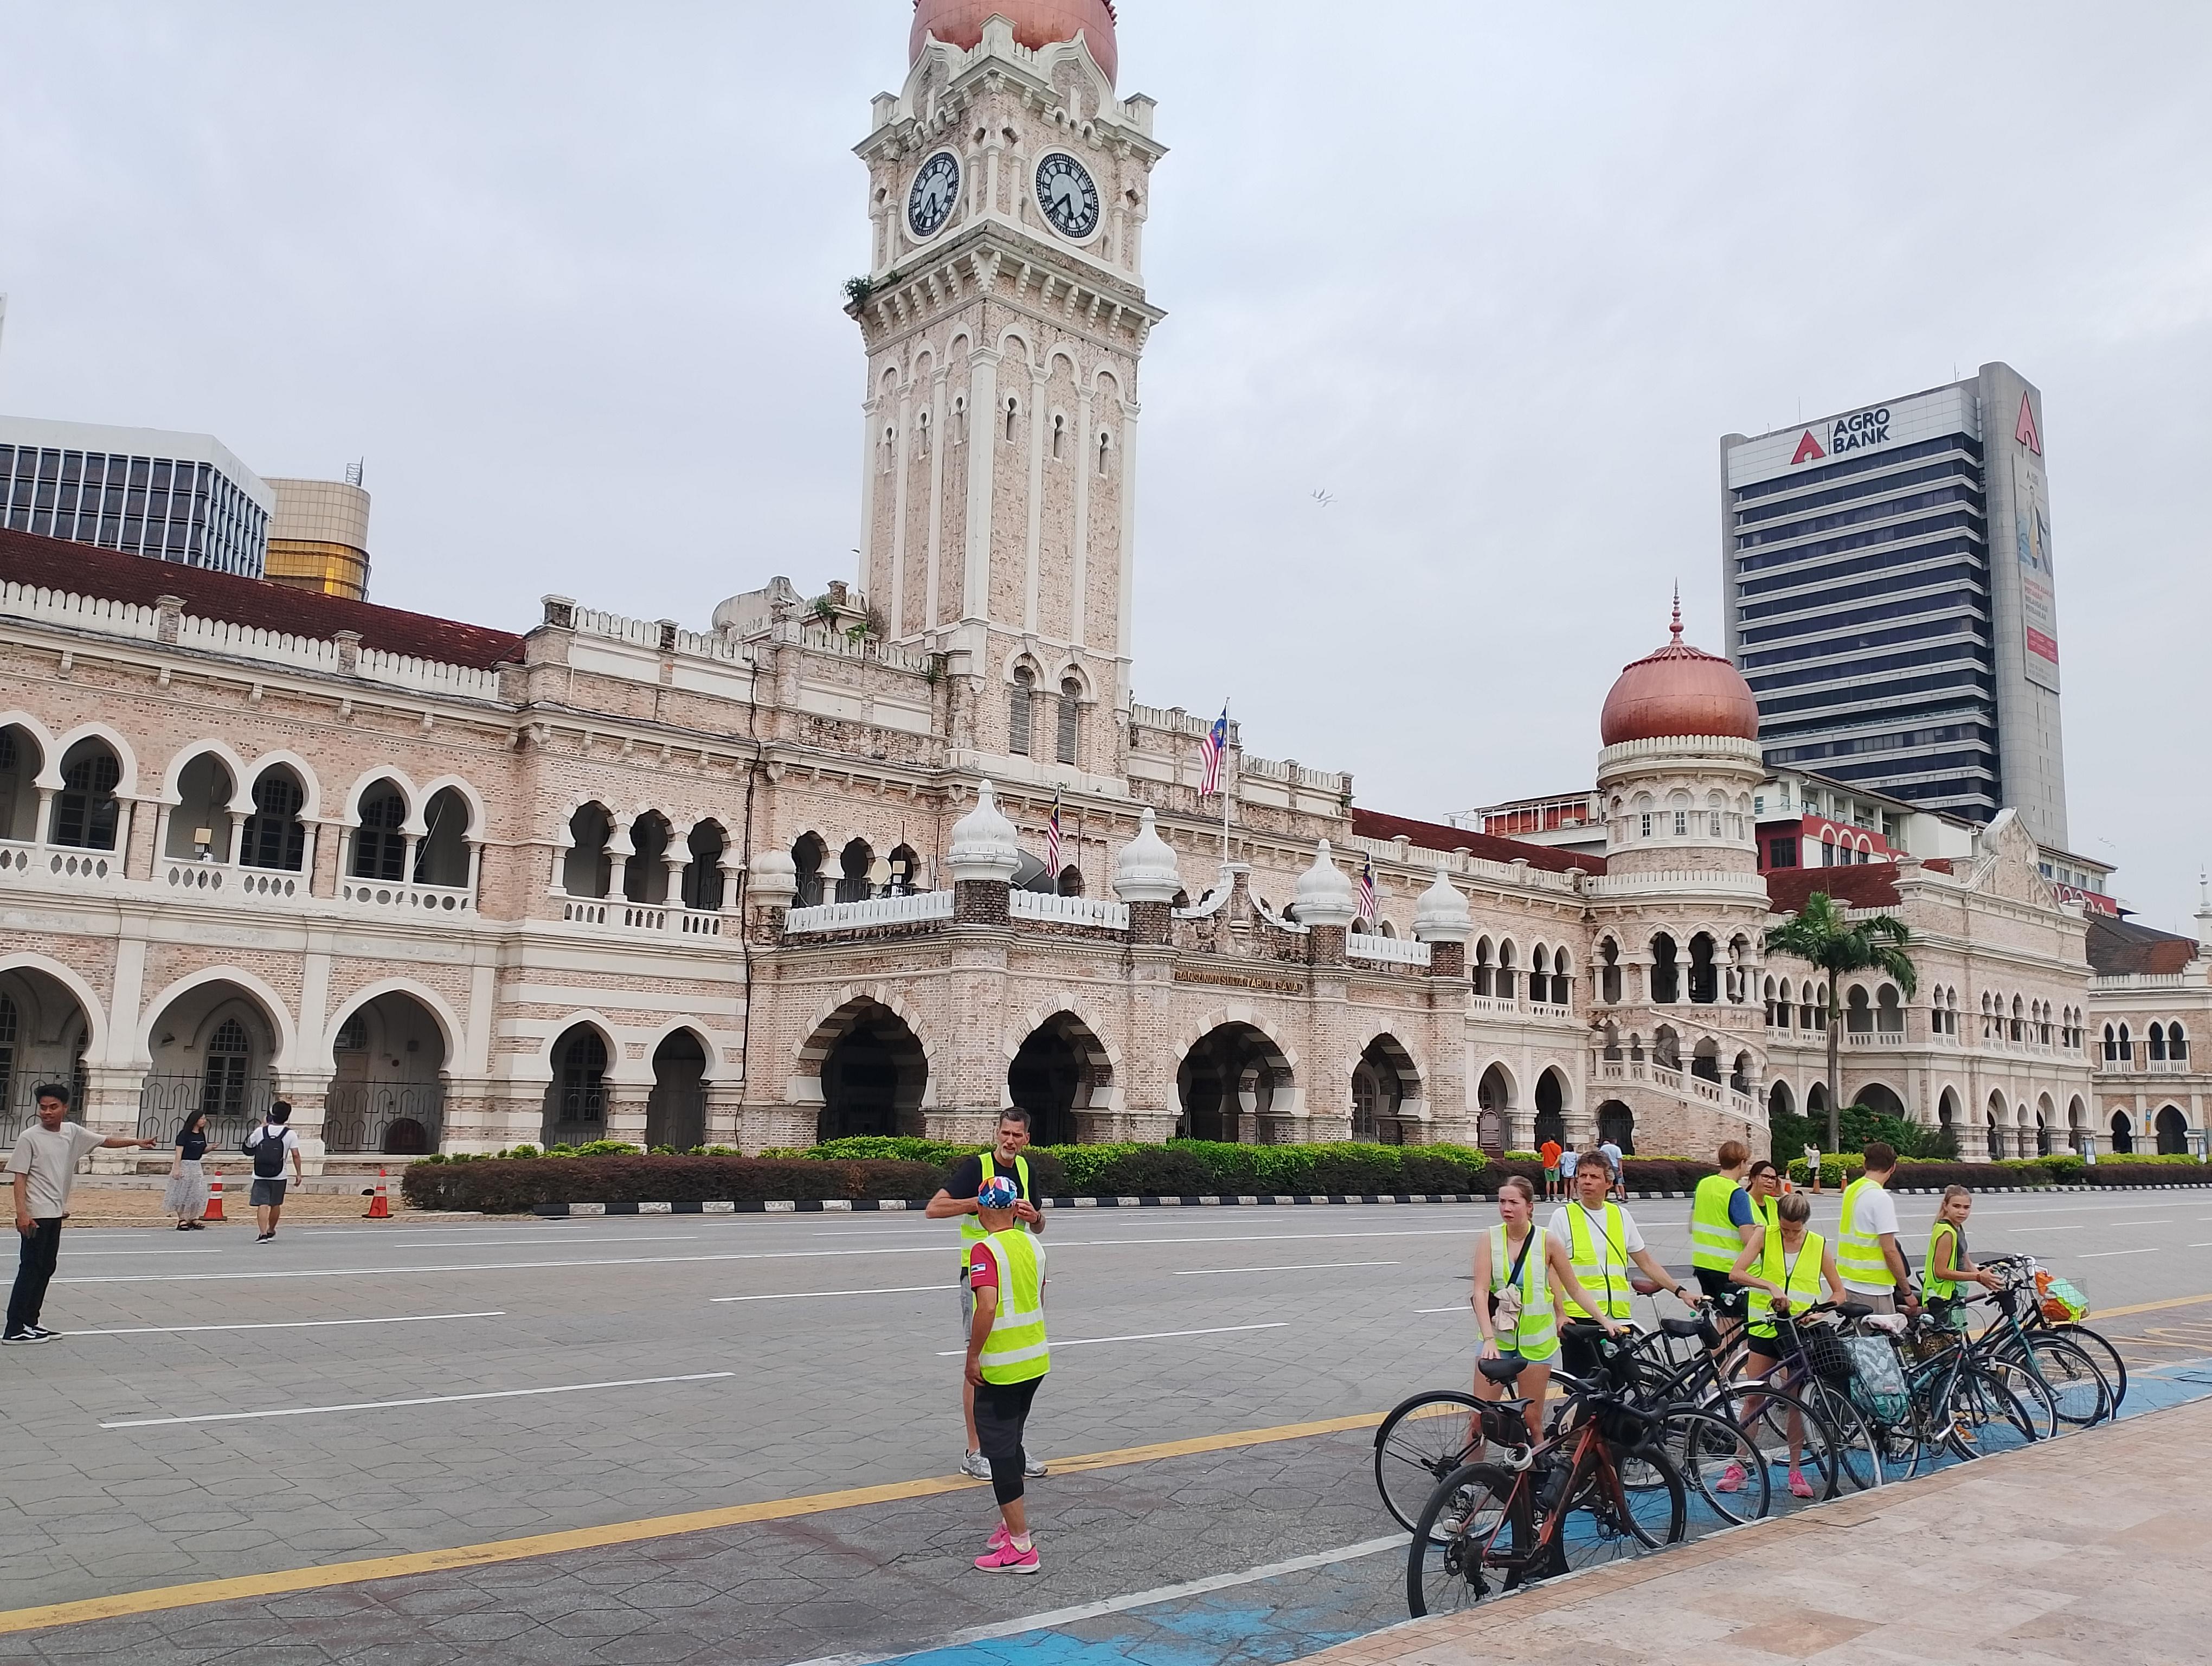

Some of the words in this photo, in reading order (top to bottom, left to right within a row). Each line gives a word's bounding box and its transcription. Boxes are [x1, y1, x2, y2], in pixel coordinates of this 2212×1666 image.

[1834, 408, 1890, 437] AGRO
[1833, 425, 1891, 454] BANK
[1176, 971, 1220, 985] BANGUNAN
